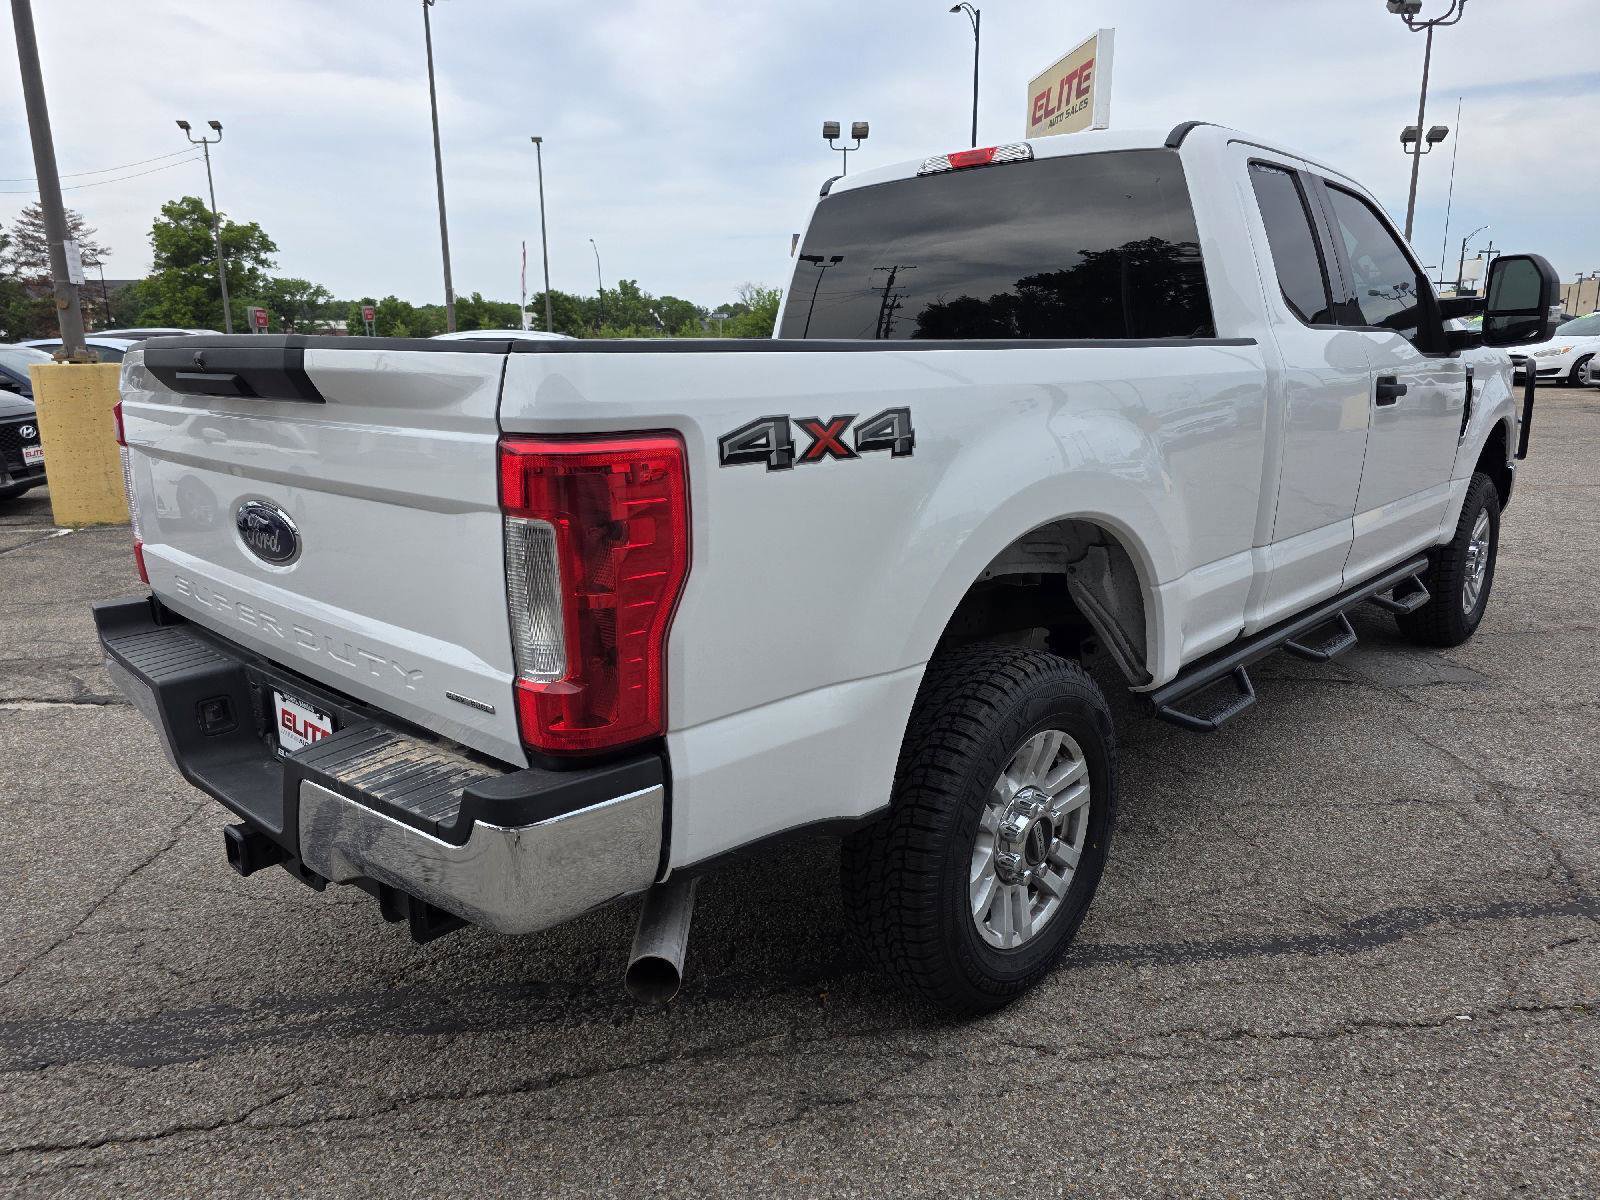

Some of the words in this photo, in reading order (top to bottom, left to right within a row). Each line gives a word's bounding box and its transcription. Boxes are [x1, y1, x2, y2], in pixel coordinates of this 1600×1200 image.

[1031, 58, 1095, 127] ELITE
[1048, 112, 1064, 129] AUTO
[1065, 97, 1089, 120] SALES
[25, 449, 44, 457] ELITE
[717, 406, 916, 473] 4X4
[244, 512, 281, 553] Ford
[175, 575, 284, 638] SUPER
[293, 623, 424, 690] DUTY
